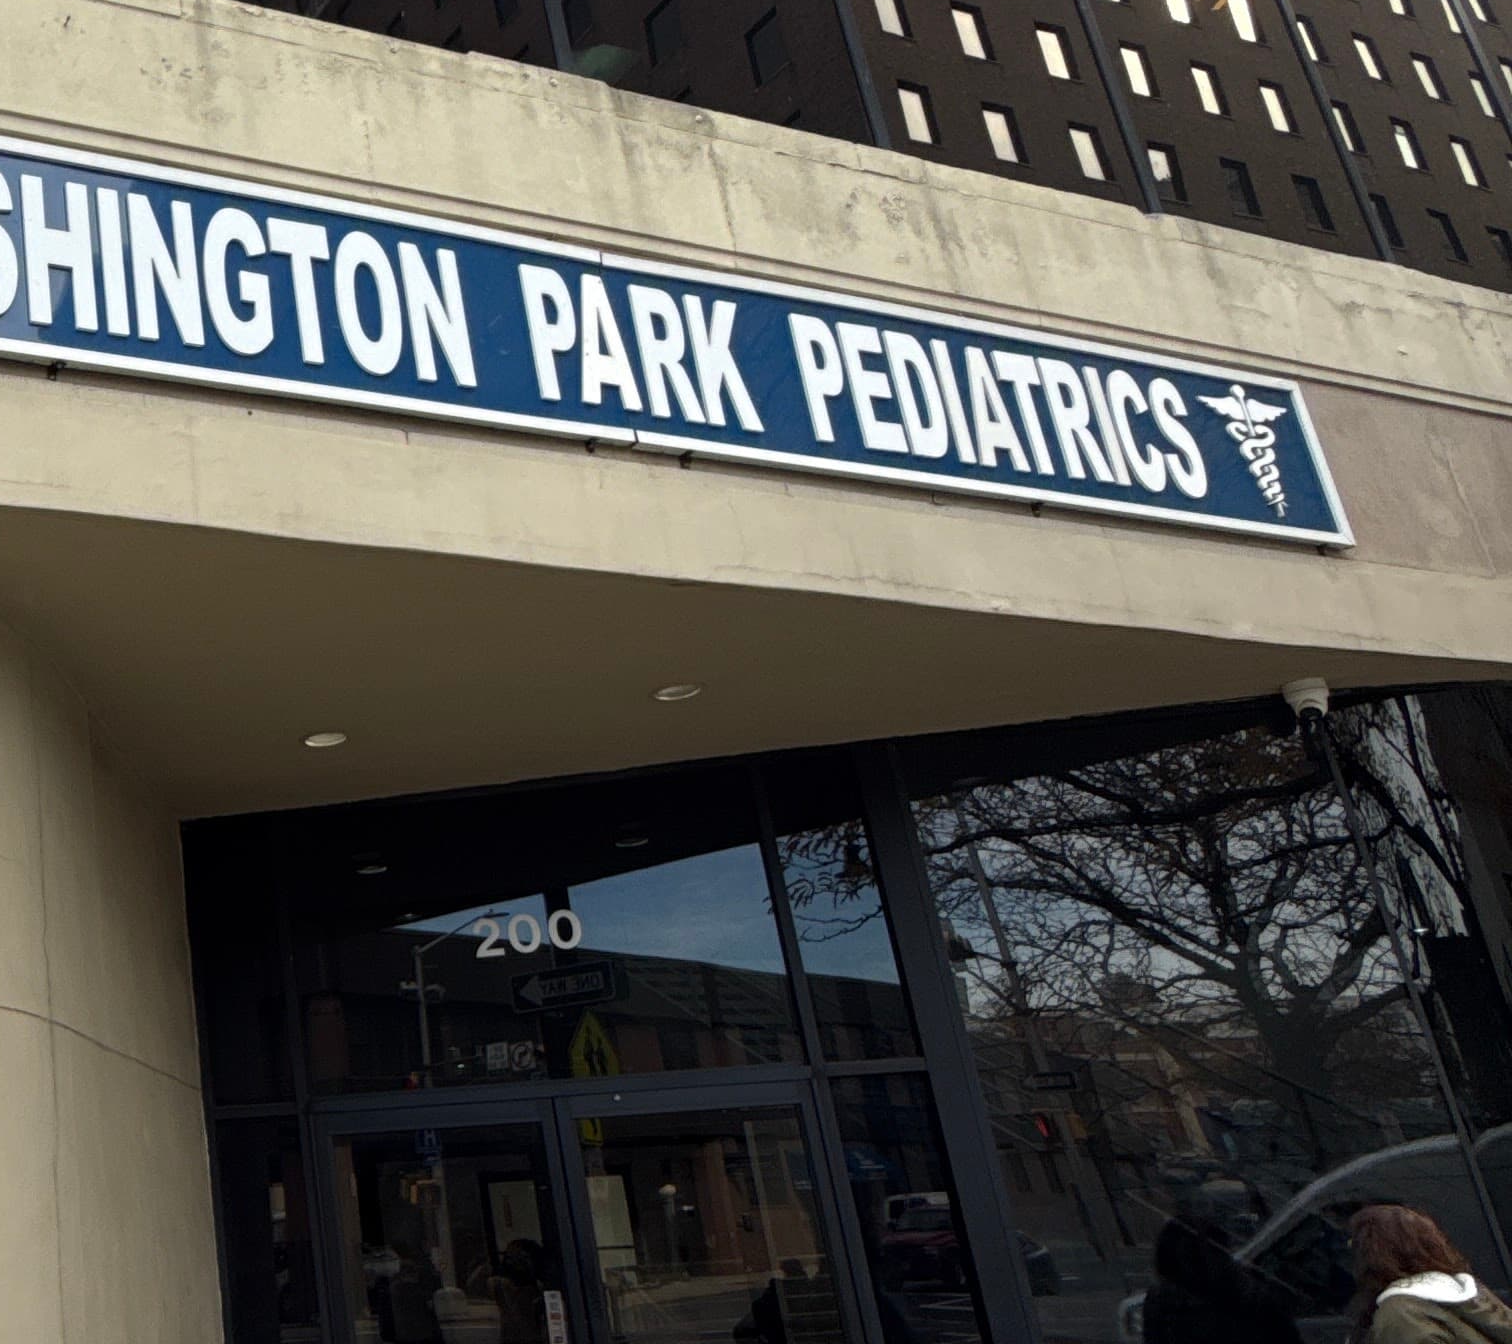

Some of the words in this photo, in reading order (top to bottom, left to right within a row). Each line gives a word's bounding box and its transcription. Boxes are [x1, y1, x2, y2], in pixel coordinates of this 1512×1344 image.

[518, 263, 764, 433] PARK
[788, 312, 1208, 500] PEDIATRICS
[472, 909, 582, 959] 200
